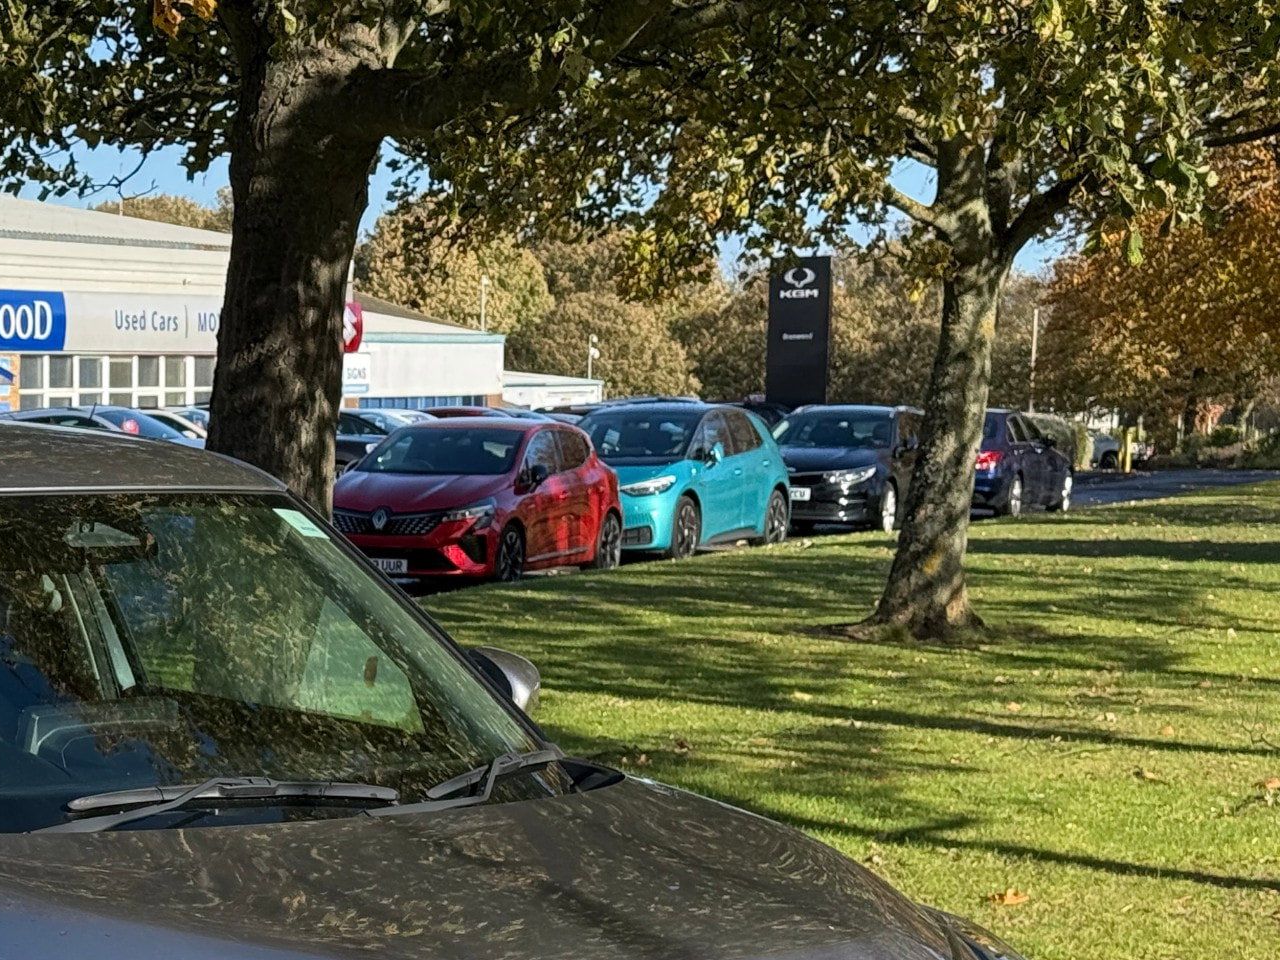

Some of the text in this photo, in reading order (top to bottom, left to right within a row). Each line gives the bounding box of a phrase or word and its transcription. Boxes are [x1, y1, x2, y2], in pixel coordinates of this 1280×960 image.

[779, 288, 819, 299] KGM
[115, 309, 220, 332] Used Cars MO
